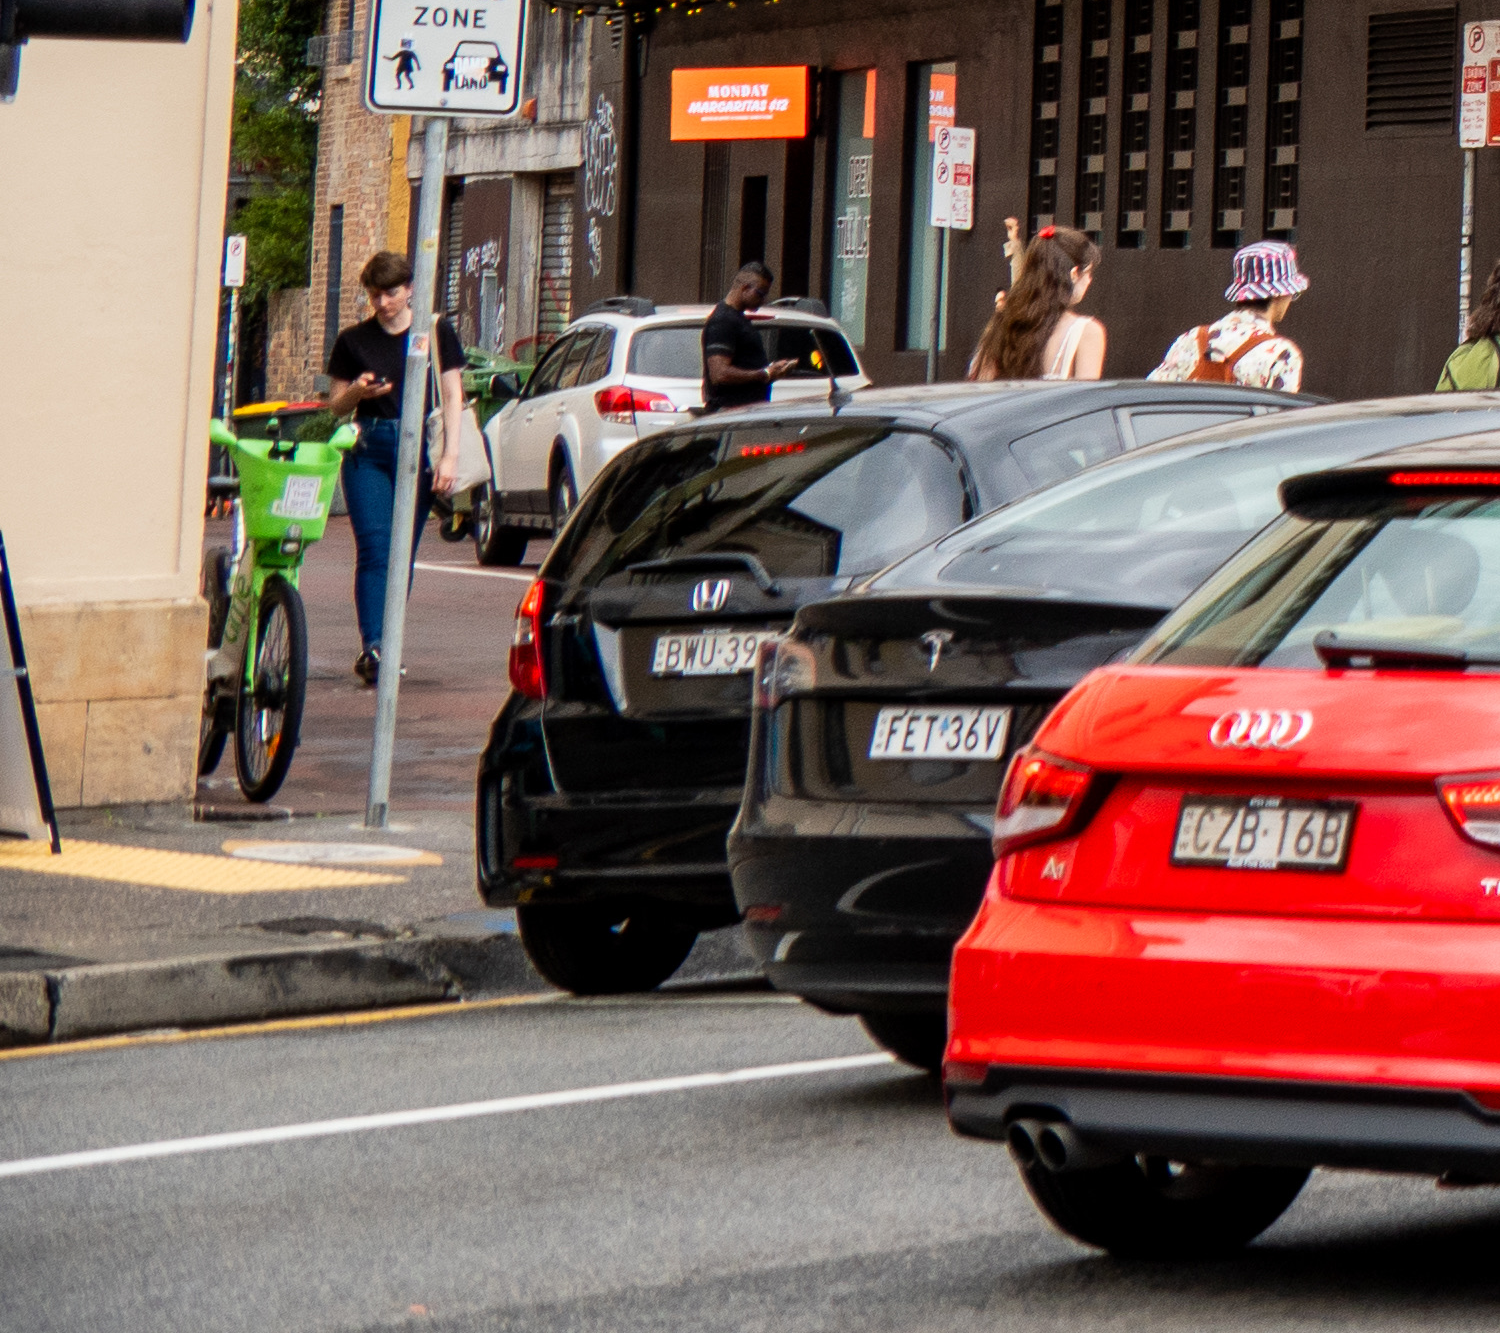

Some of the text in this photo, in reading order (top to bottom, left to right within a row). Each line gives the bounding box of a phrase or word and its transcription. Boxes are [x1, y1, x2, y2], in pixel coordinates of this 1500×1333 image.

[412, 6, 488, 29] ZONE
[707, 83, 769, 99] MONDAY
[686, 99, 767, 115] MARGARITAS
[664, 635, 757, 670] BWU·39
[1041, 856, 1065, 880] A1
